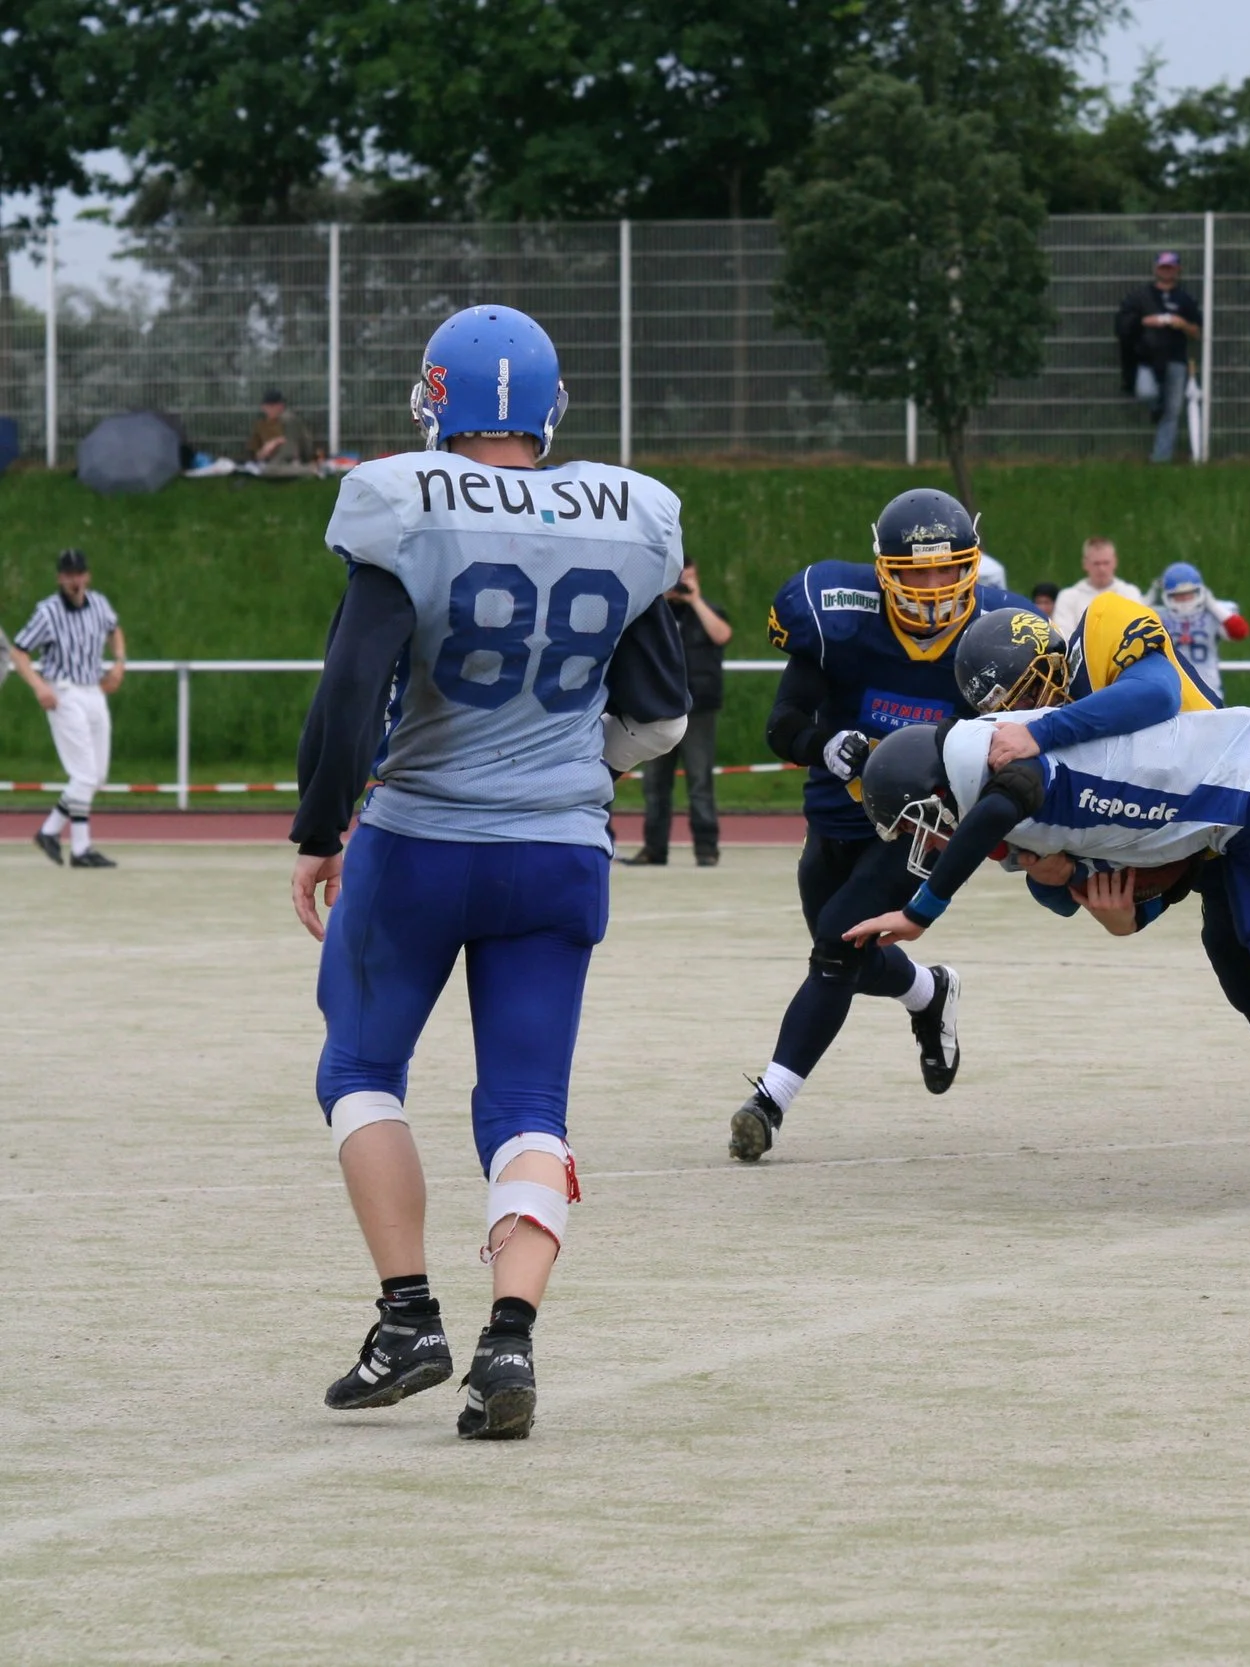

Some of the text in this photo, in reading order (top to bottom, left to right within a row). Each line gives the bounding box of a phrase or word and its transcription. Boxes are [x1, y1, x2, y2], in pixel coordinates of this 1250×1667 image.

[416, 468, 629, 525] neu.sw
[433, 561, 629, 714] 88
[871, 698, 944, 720] FITNESS
[871, 713, 909, 727] COMP
[412, 1334, 447, 1351] APE
